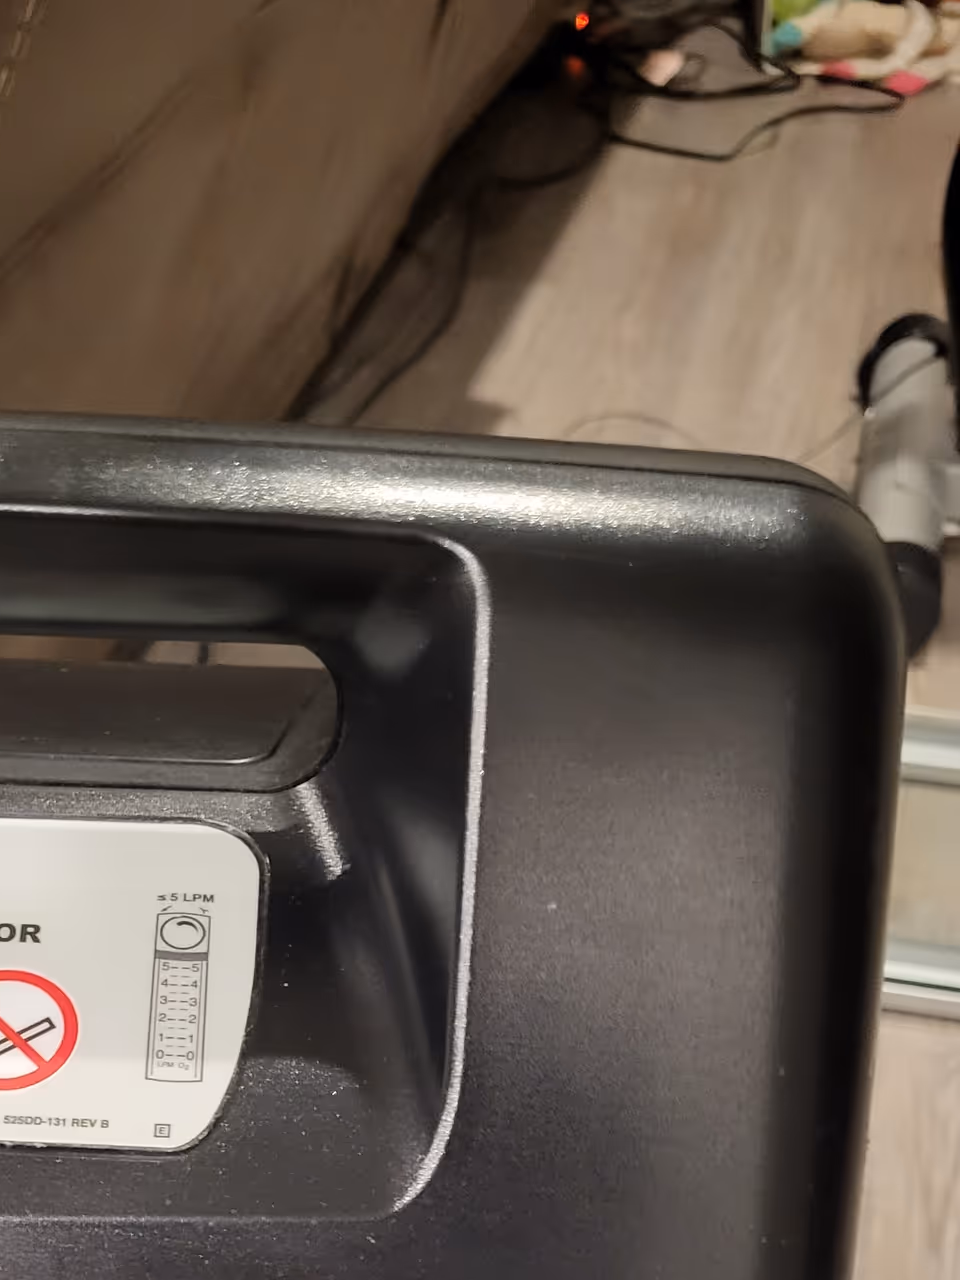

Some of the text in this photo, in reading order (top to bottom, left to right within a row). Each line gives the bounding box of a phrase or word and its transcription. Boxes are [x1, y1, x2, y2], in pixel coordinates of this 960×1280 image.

[183, 893, 215, 903] LPM
[161, 961, 200, 973] 5 5
[160, 979, 198, 989] 4 4
[159, 995, 198, 1007] 3 3
[158, 1013, 197, 1024] 2 2
[157, 1033, 194, 1044] 1 1
[155, 1050, 195, 1061] 0 0
[71, 1118, 97, 1128] REV
[100, 1119, 109, 1129] B
